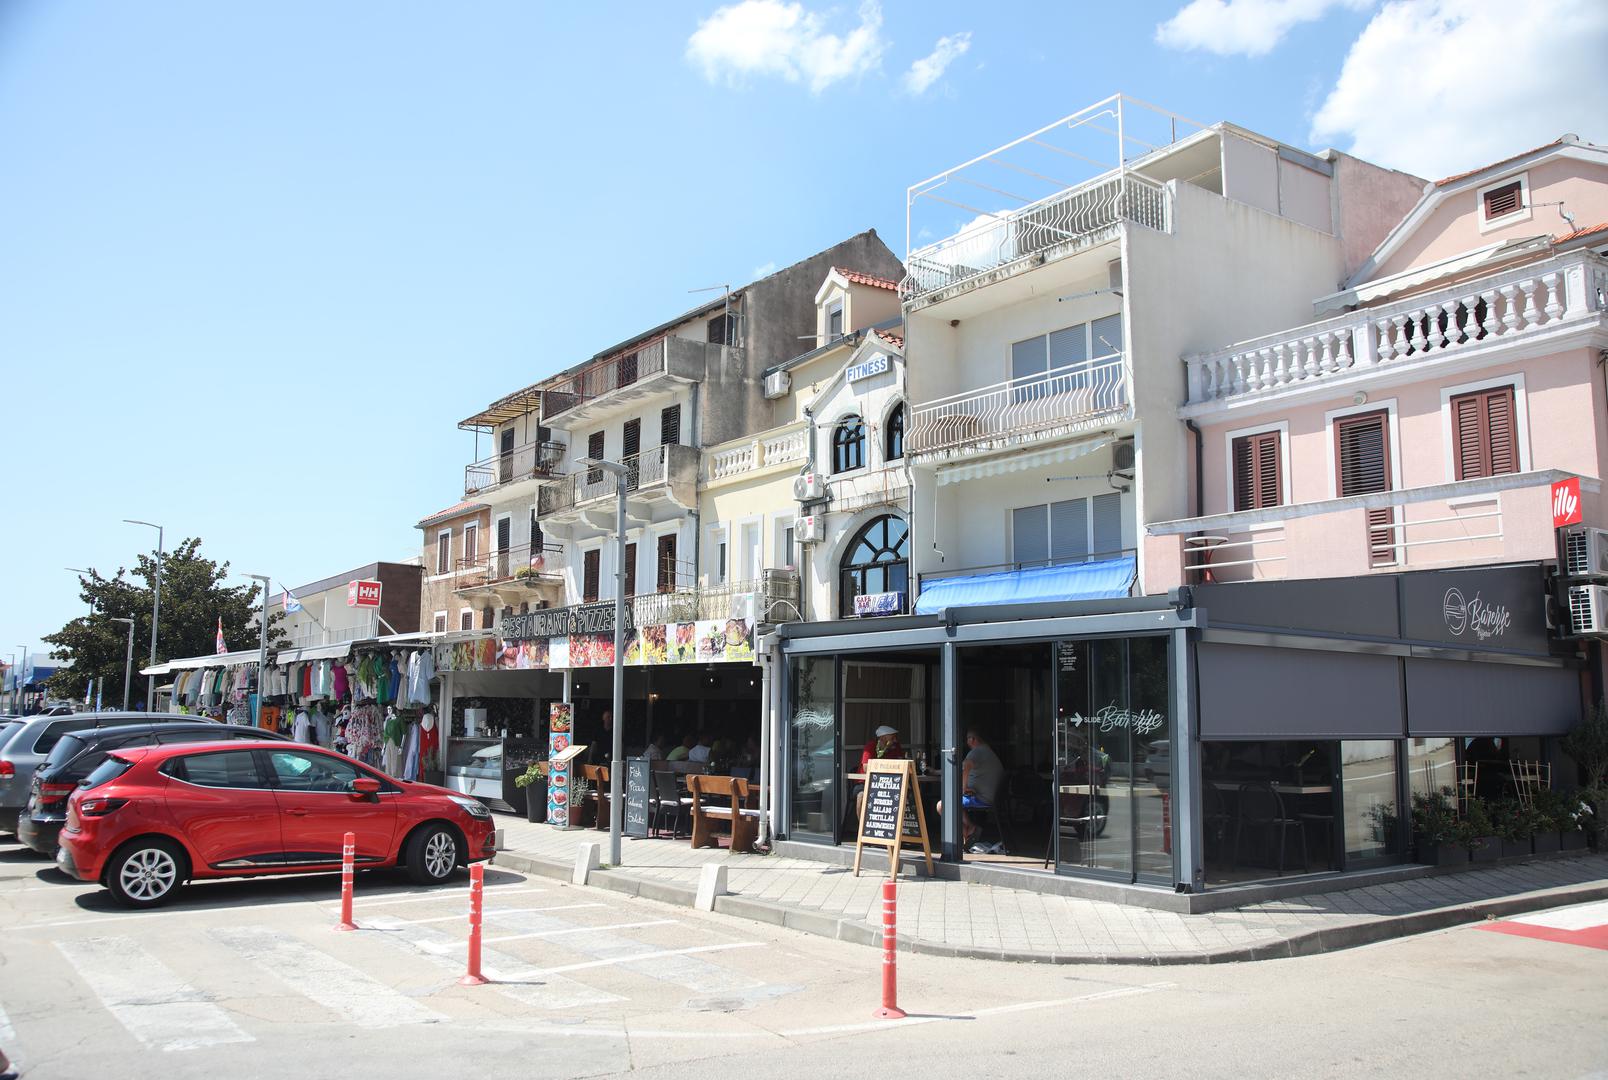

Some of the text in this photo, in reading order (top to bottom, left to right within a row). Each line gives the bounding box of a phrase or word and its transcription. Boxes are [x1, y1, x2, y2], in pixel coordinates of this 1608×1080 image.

[848, 358, 886, 381] FITNESS
[1553, 486, 1577, 521] illy
[359, 586, 379, 597] HH
[502, 611, 569, 639] RESTAURANT
[578, 604, 632, 633] PIZZERA
[869, 813, 895, 822] TORTILLAS
[872, 805, 892, 813] SALADS
